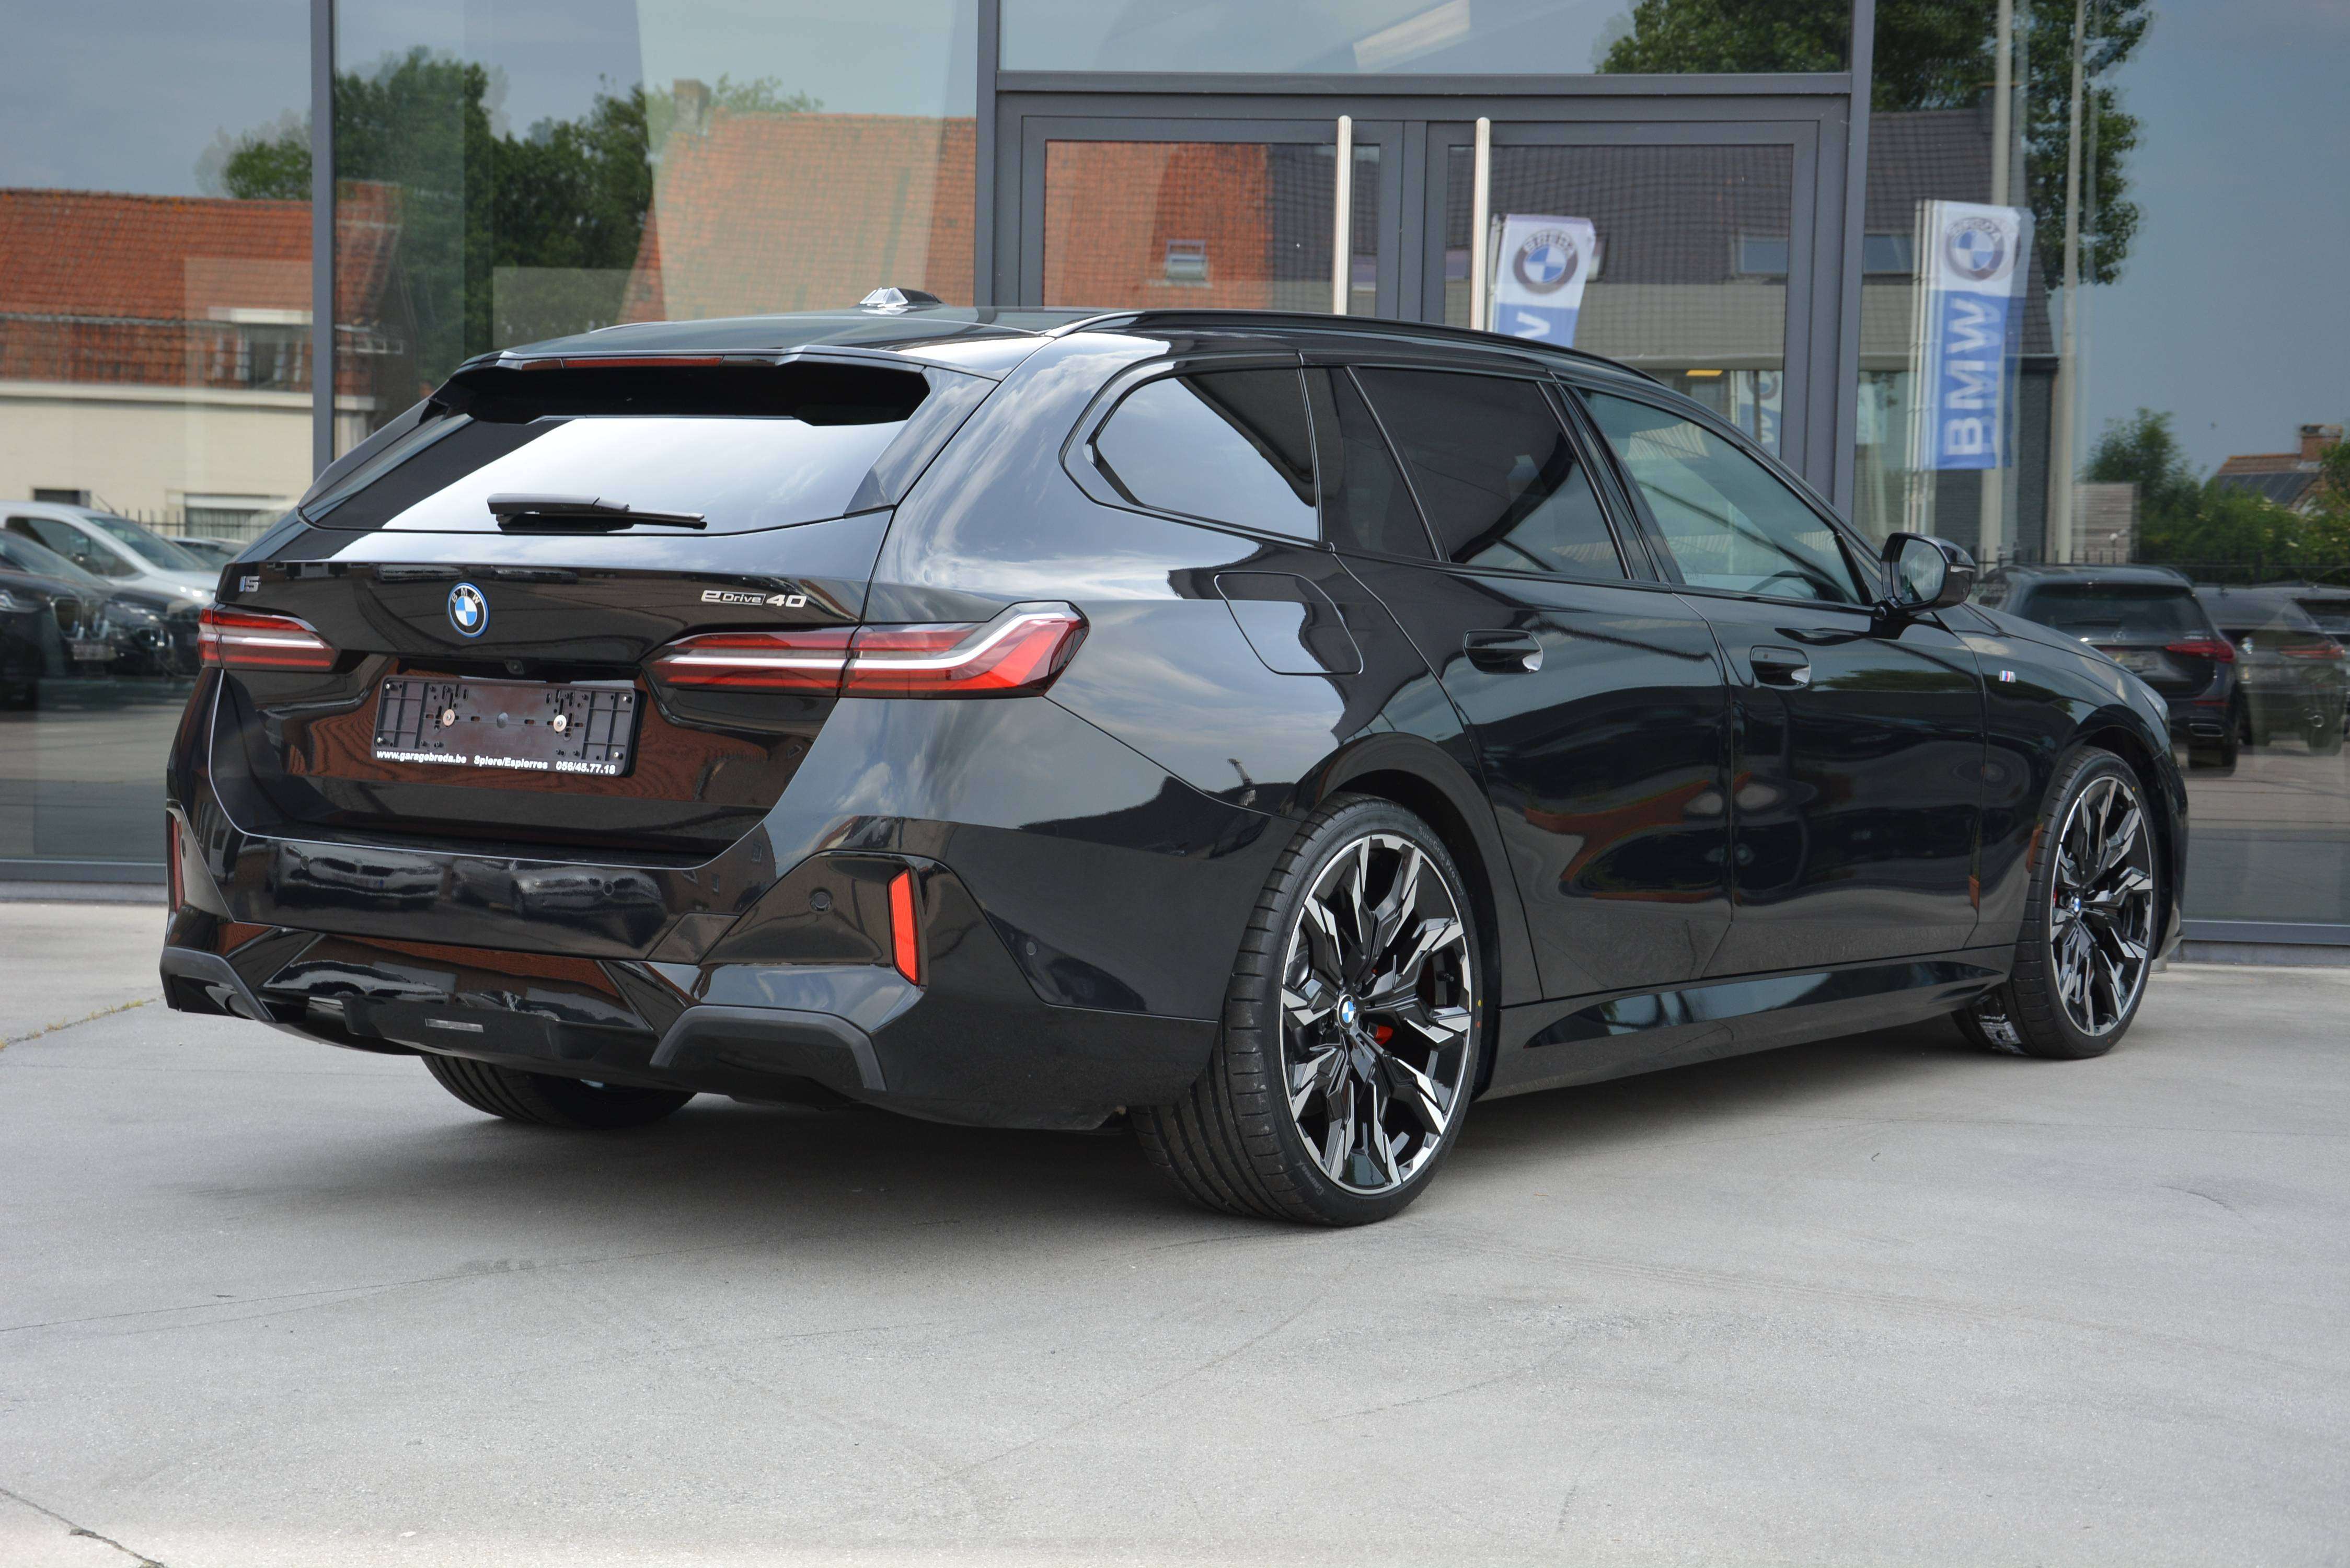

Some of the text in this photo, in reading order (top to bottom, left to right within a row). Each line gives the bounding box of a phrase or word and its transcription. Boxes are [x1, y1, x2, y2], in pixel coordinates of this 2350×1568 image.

[1943, 297, 1989, 456] BMW
[451, 587, 480, 604] BMW
[376, 750, 616, 775] www.garagebreda.be Spiere/Espierres 056/45.77.18
